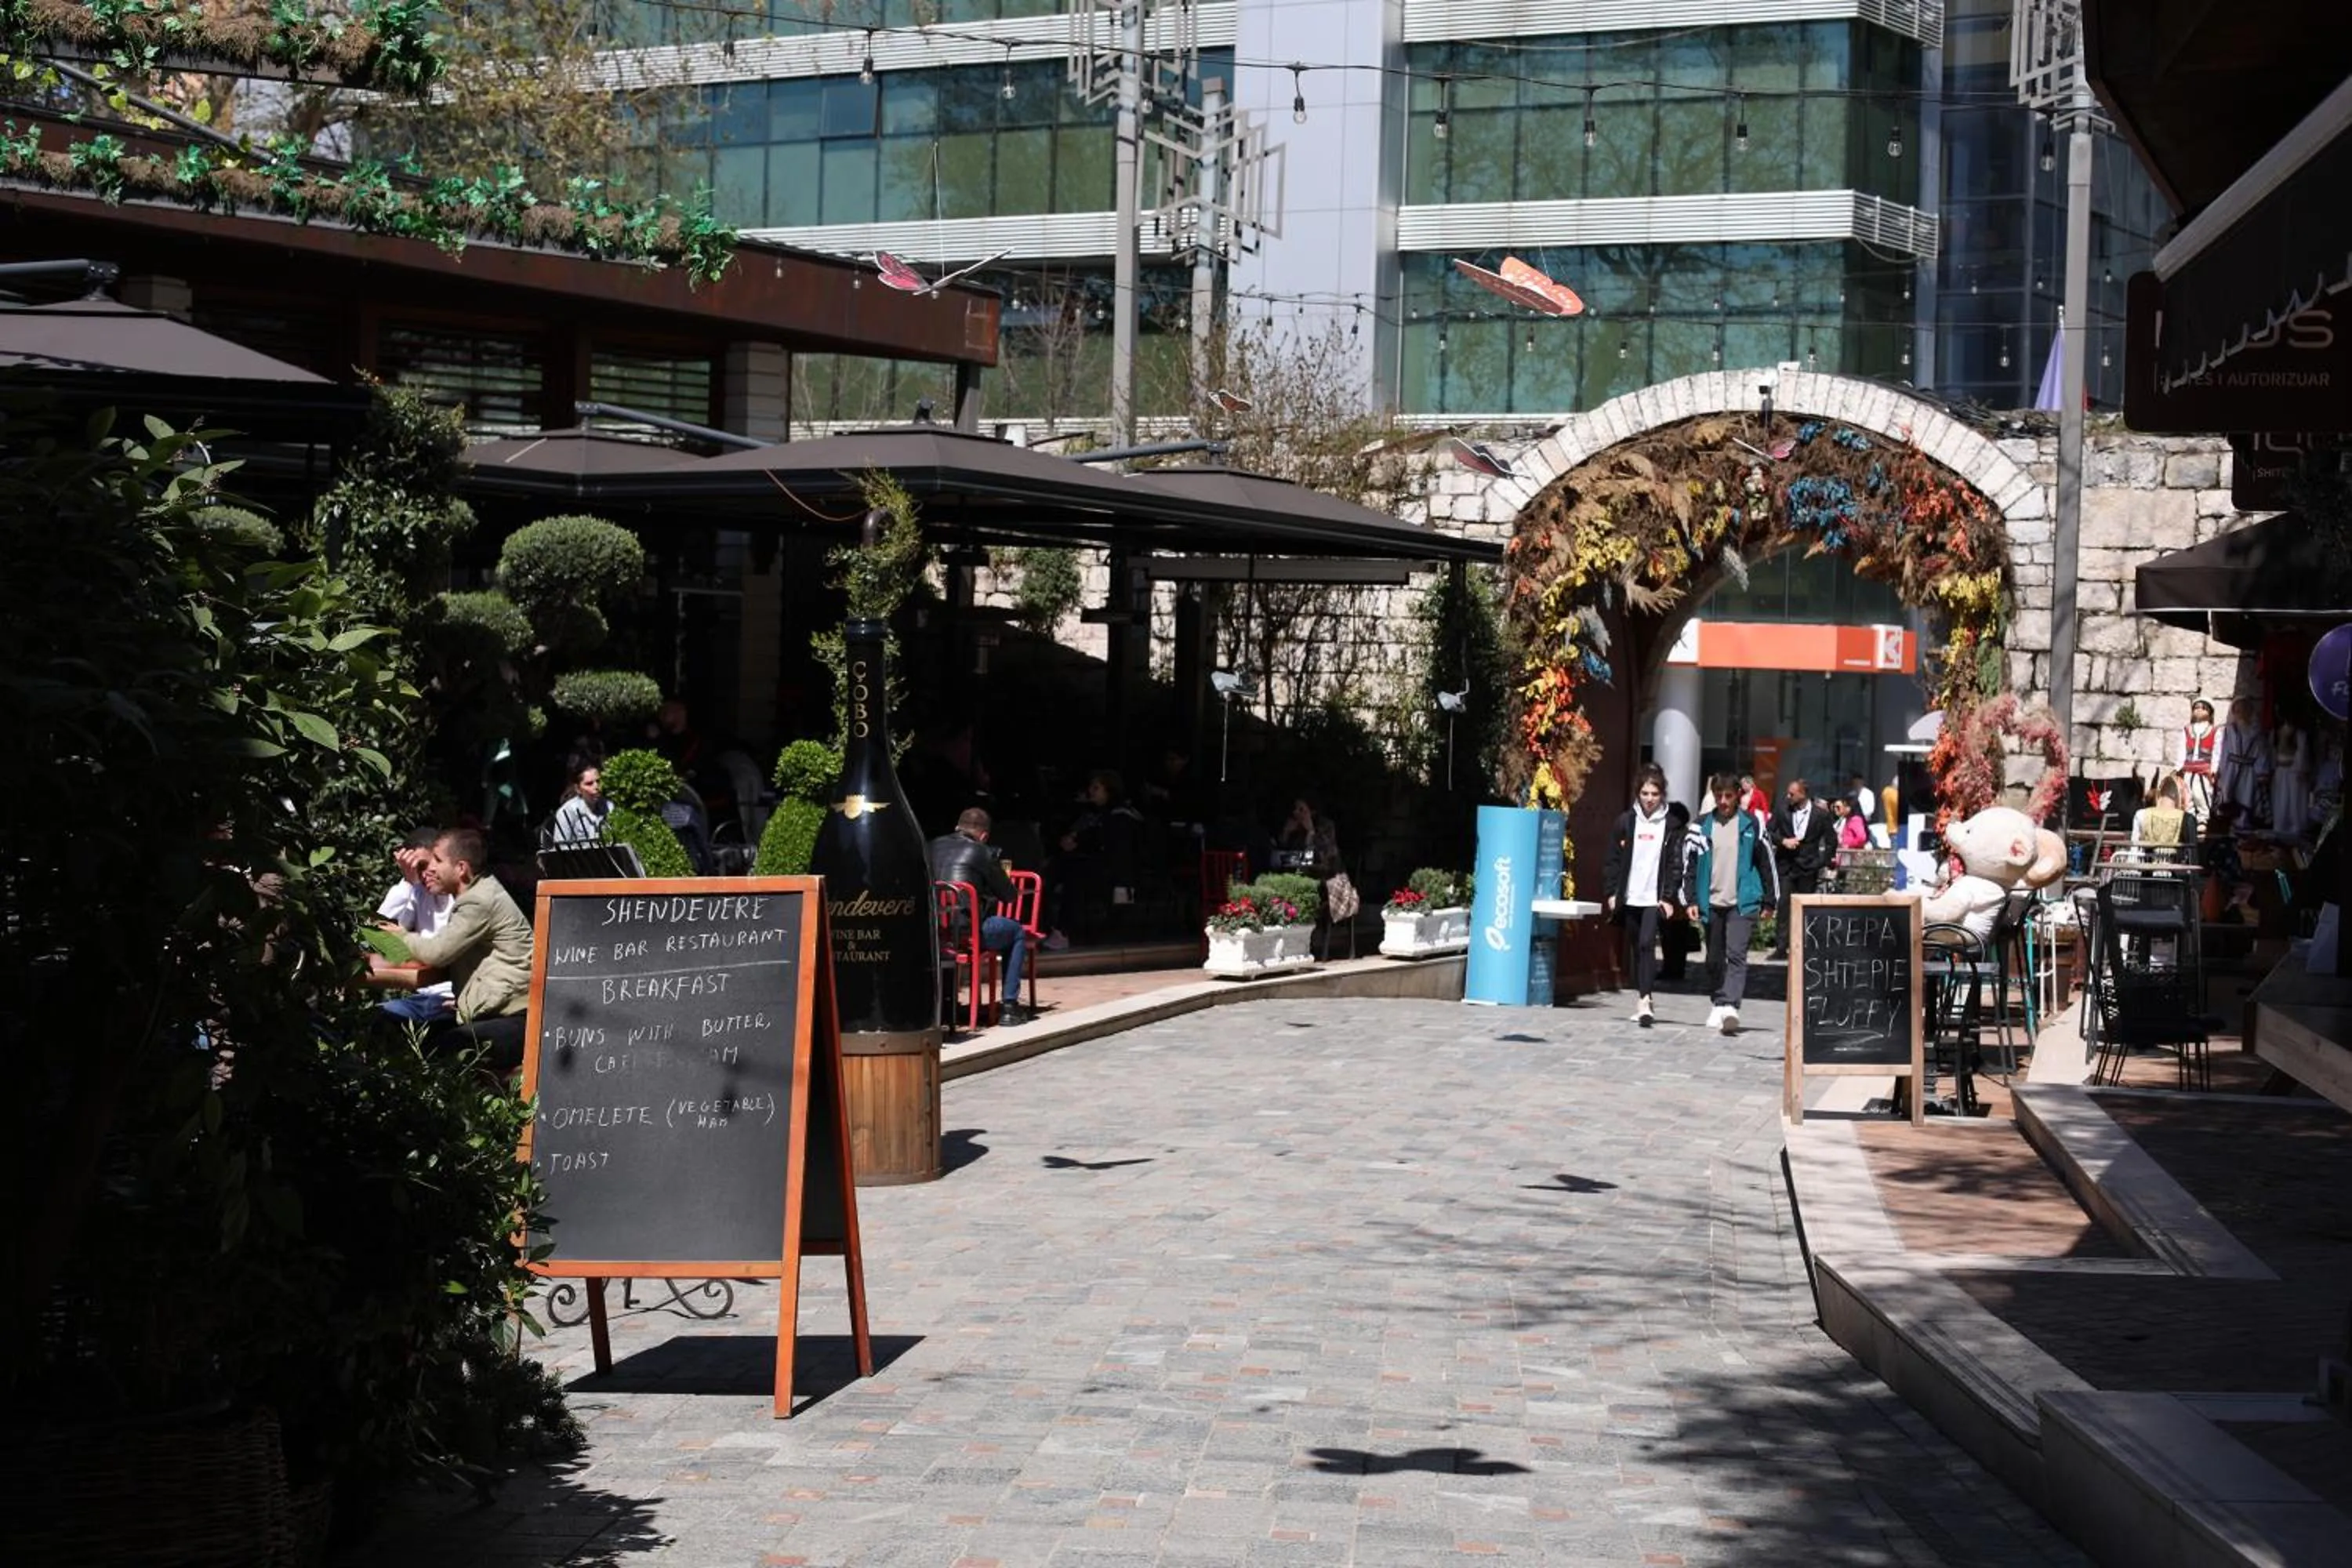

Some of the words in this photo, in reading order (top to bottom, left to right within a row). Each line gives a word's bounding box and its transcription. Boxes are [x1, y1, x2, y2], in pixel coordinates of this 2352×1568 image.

[2227, 371, 2331, 387] AUTORIZUAR
[1494, 855, 1512, 929] ecosoft
[602, 896, 770, 926] SHENDEVERE
[554, 946, 598, 966] WINE
[614, 940, 649, 961] BAR
[666, 928, 788, 953] RESTAURANT
[857, 928, 882, 940] BAR
[1804, 915, 1896, 949] KREPA
[835, 951, 891, 962] TAURANT
[1804, 956, 1907, 991] SHTEPIE
[601, 973, 731, 1005] BREAKFAST
[1806, 995, 1901, 1038] FLUFFY
[555, 1026, 606, 1049] BUNS
[627, 1023, 674, 1047] WITH
[552, 1105, 655, 1130] OMELETE
[550, 1152, 610, 1175] TOAST
